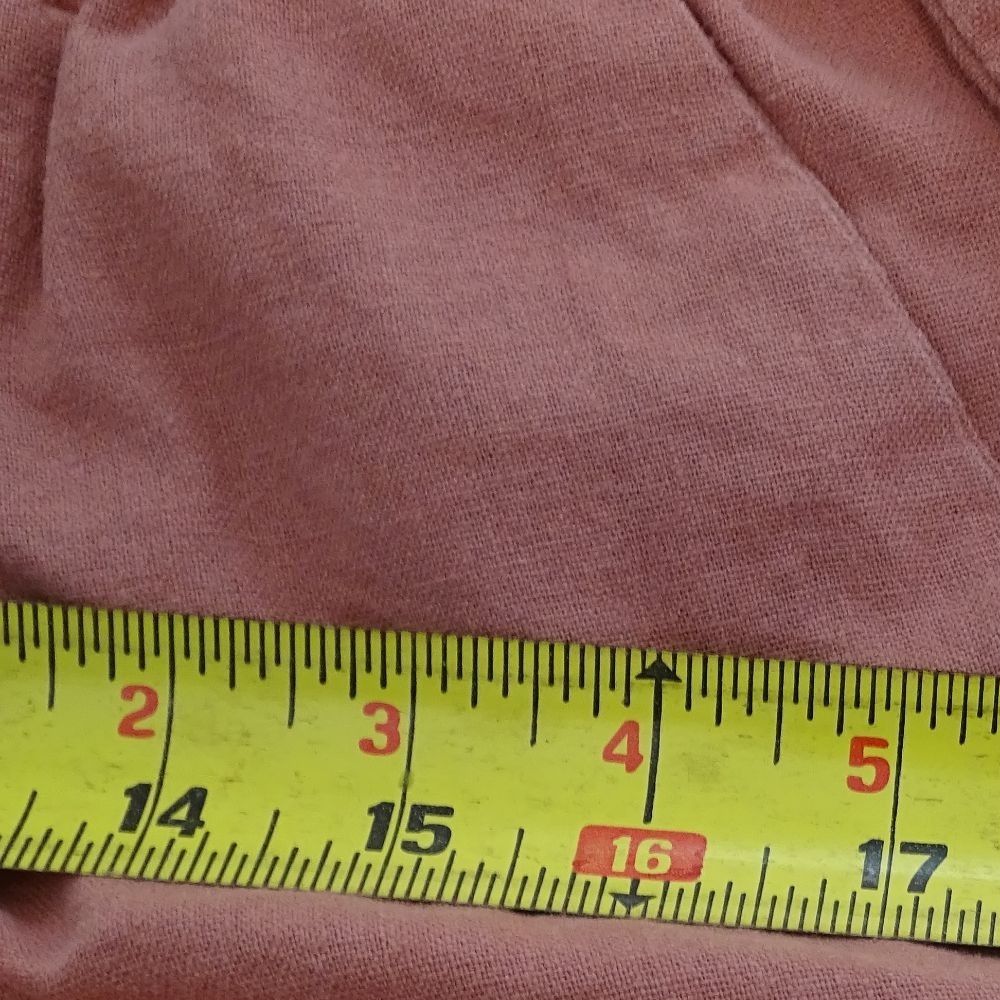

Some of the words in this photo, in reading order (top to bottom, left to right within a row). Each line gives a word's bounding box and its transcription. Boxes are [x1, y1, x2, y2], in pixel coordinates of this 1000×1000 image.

[118, 685, 159, 738] 2
[359, 702, 401, 756] 3
[603, 721, 644, 773] 4
[846, 737, 891, 794] 5
[119, 783, 209, 836] 14
[365, 801, 454, 855] 15
[610, 836, 673, 875] 16
[858, 839, 948, 893] 17
